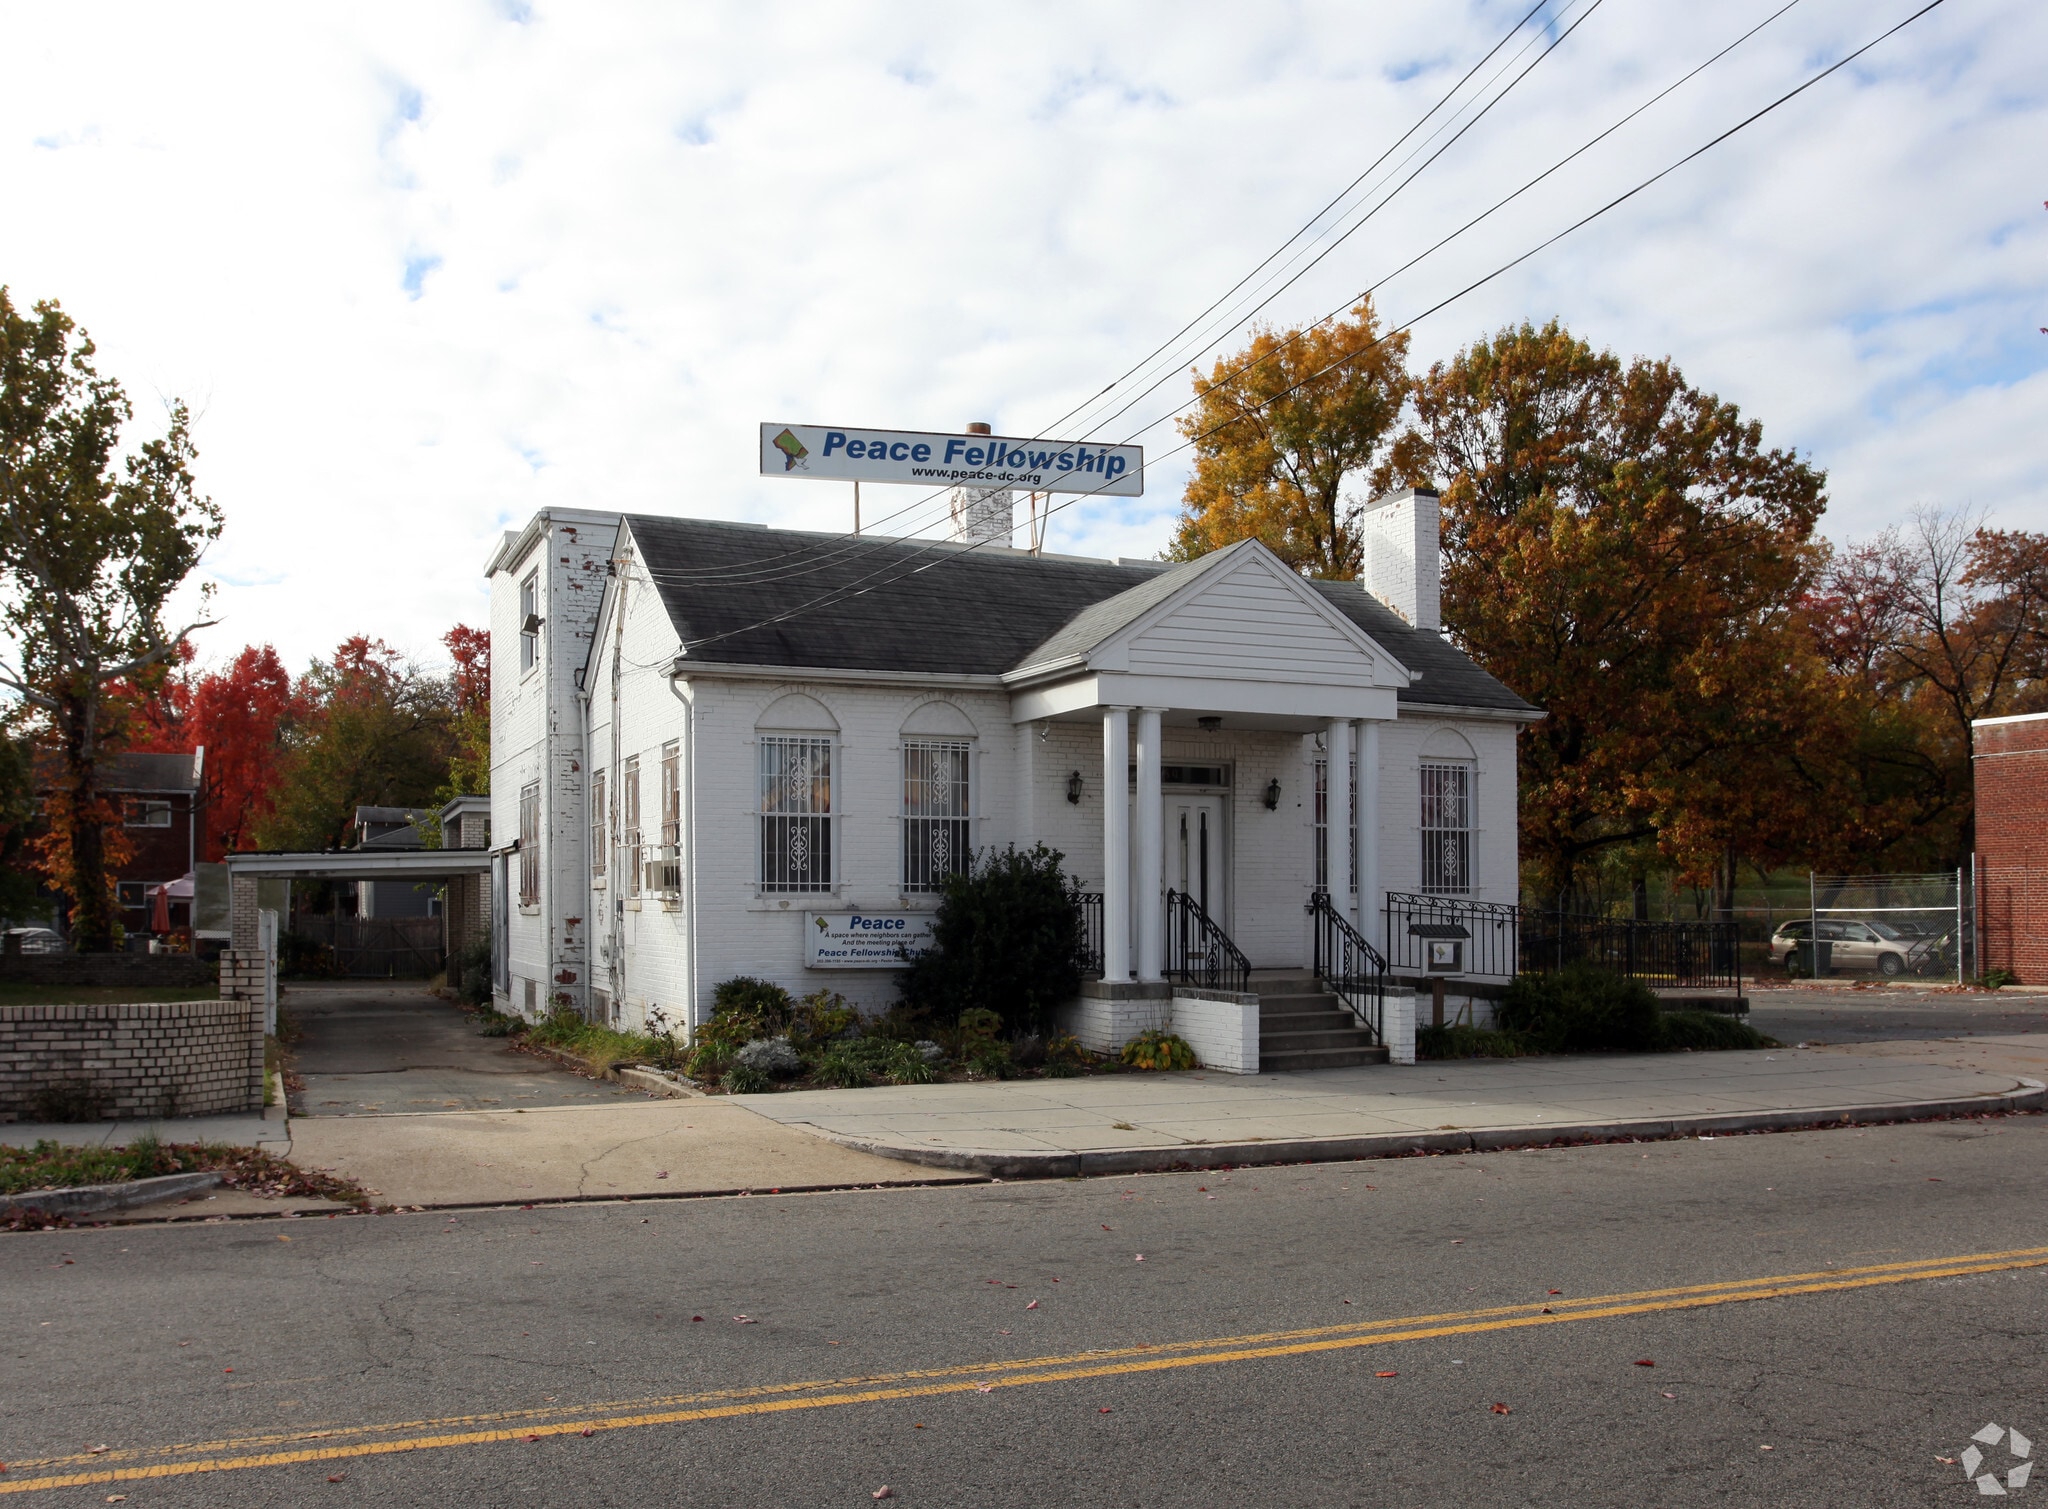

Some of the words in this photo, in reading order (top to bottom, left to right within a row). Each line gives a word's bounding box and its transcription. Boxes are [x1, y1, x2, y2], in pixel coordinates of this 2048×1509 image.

[822, 431, 932, 463] Peace
[943, 439, 1127, 480] Fellowship
[911, 467, 1042, 485] www.peace-dc.org
[849, 915, 906, 930] Peace
[831, 932, 850, 940] space
[869, 931, 900, 940] neighbors
[912, 931, 932, 940] gather
[866, 939, 891, 947] meeting
[818, 948, 848, 957] Peace
